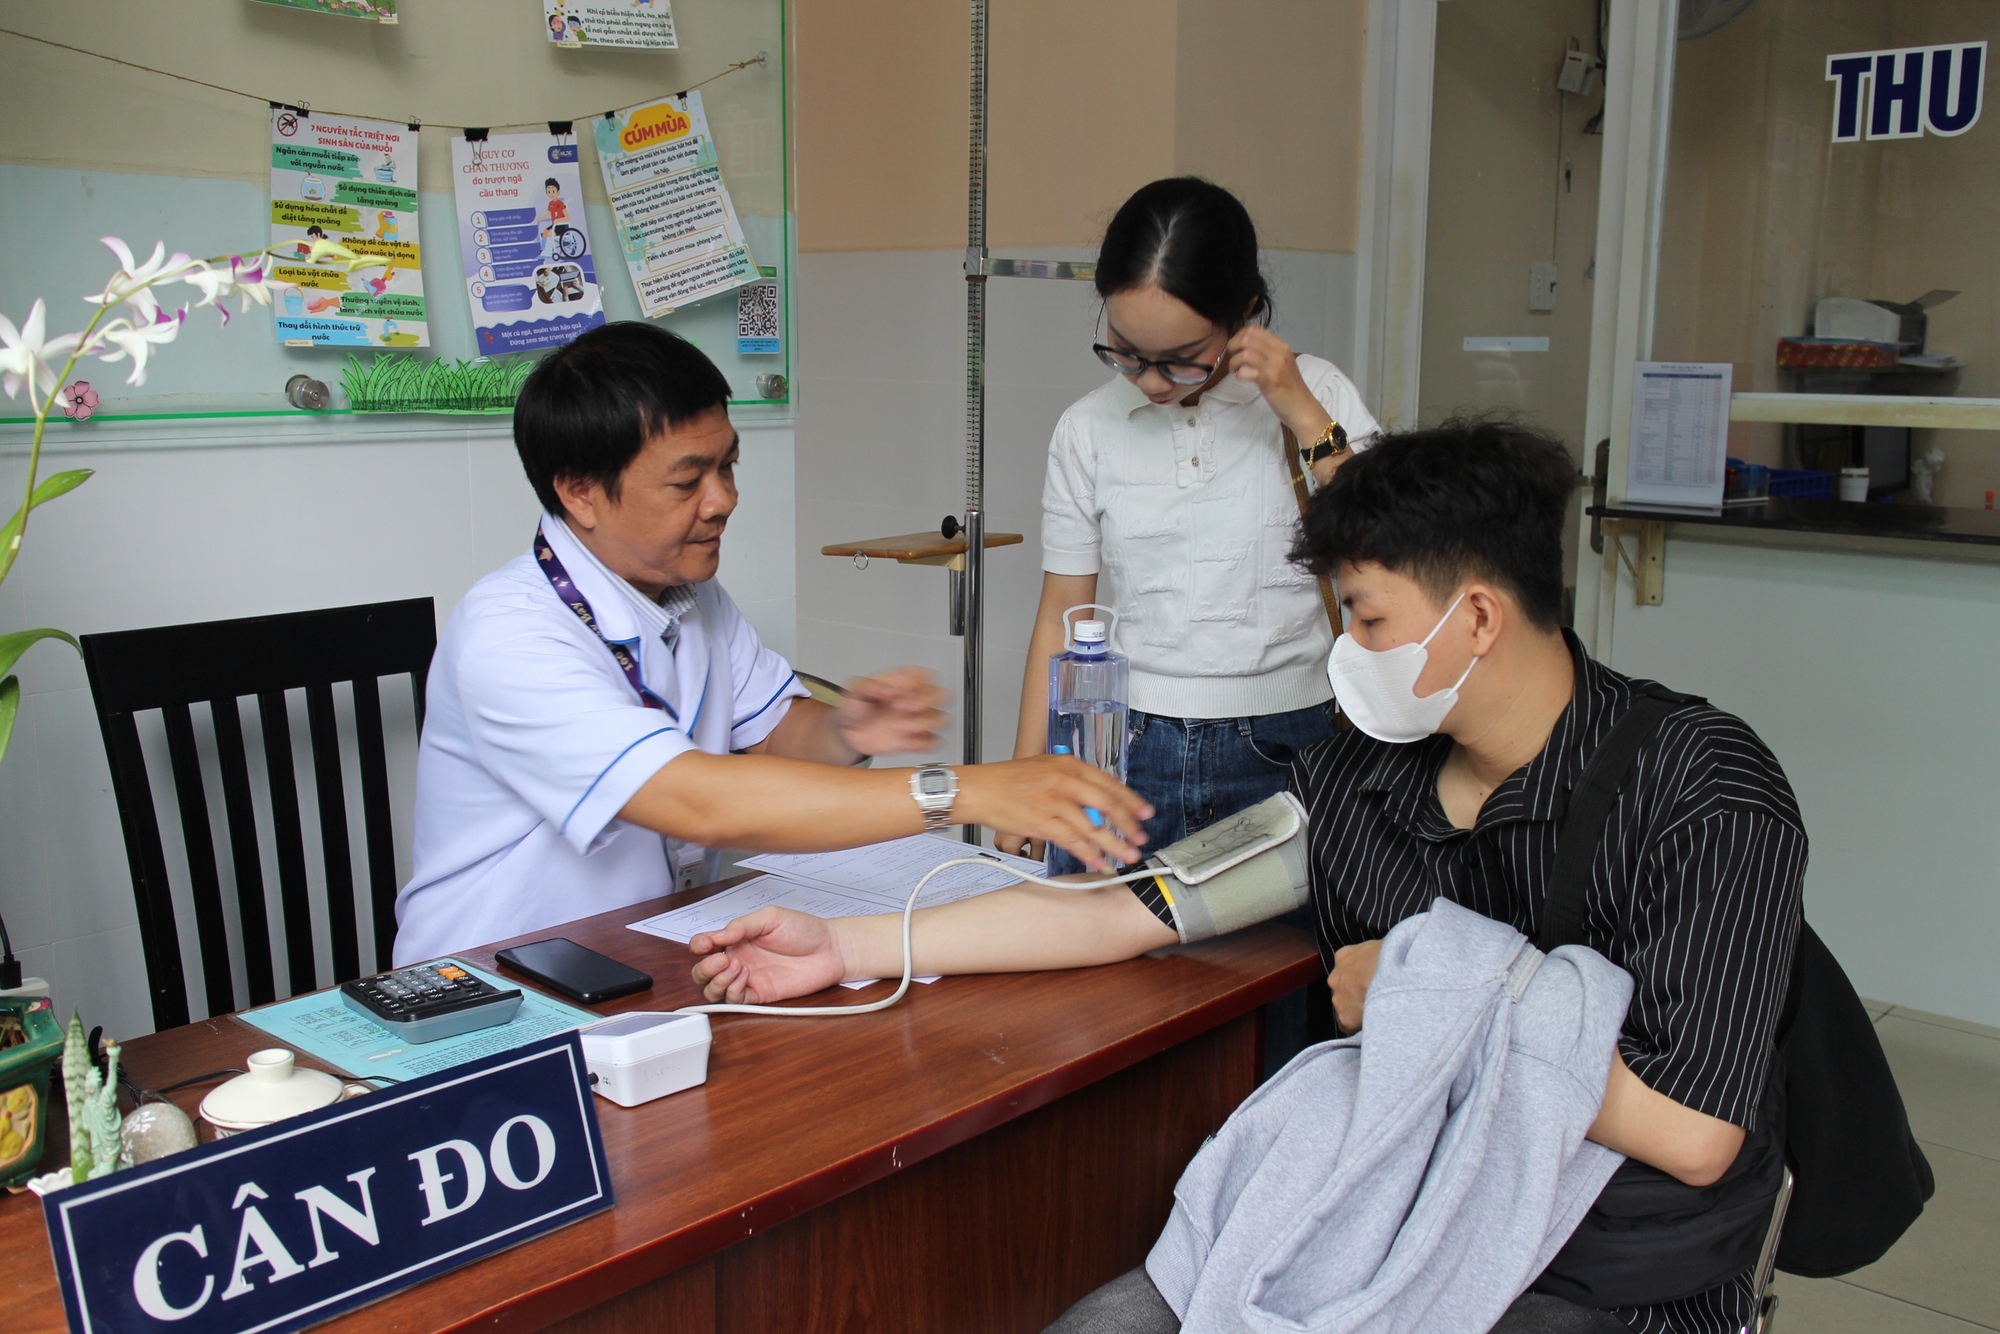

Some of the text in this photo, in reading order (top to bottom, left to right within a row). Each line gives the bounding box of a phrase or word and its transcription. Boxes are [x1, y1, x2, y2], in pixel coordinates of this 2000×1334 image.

[1826, 41, 1987, 142] THU
[316, 124, 348, 135] NGUYÊN
[349, 126, 362, 138] TẮC
[364, 131, 384, 142] TRIỆT
[386, 134, 399, 142] NƠI
[624, 114, 687, 145] CÚM MÙA
[318, 138, 392, 152] SINH SẢN CỦA MUỖI
[276, 146, 359, 162] Ngăn cản muỗi tiếp xúc
[475, 149, 515, 159] NGUY CƠ
[303, 159, 326, 170] nguồn
[327, 163, 344, 171] nước
[490, 162, 530, 171] THƯƠNG
[485, 176, 506, 185] trượt
[508, 174, 522, 184] ngã
[338, 183, 416, 198] Sử dụng thiên địch của
[496, 189, 518, 197] thang
[357, 197, 398, 208] lăng quăng
[285, 204, 304, 212] dụng
[306, 204, 320, 212] hóa
[321, 204, 337, 214] chất
[338, 206, 347, 215] để
[282, 214, 341, 226] diệt lăng quăng
[342, 237, 366, 246] Không
[368, 237, 376, 246] để
[377, 239, 388, 247] các
[388, 251, 395, 259] bị
[397, 251, 415, 260] đọng
[279, 268, 295, 276] Loại
[308, 270, 320, 278] vật
[321, 270, 339, 278] chứa
[341, 296, 369, 304] Thường
[278, 322, 298, 330] Thay
[299, 320, 311, 329] đổi
[313, 322, 330, 330] hình
[332, 322, 348, 330] thức
[570, 602, 634, 672] 100 Bay
[133, 1113, 557, 1322] CÂN ĐO
